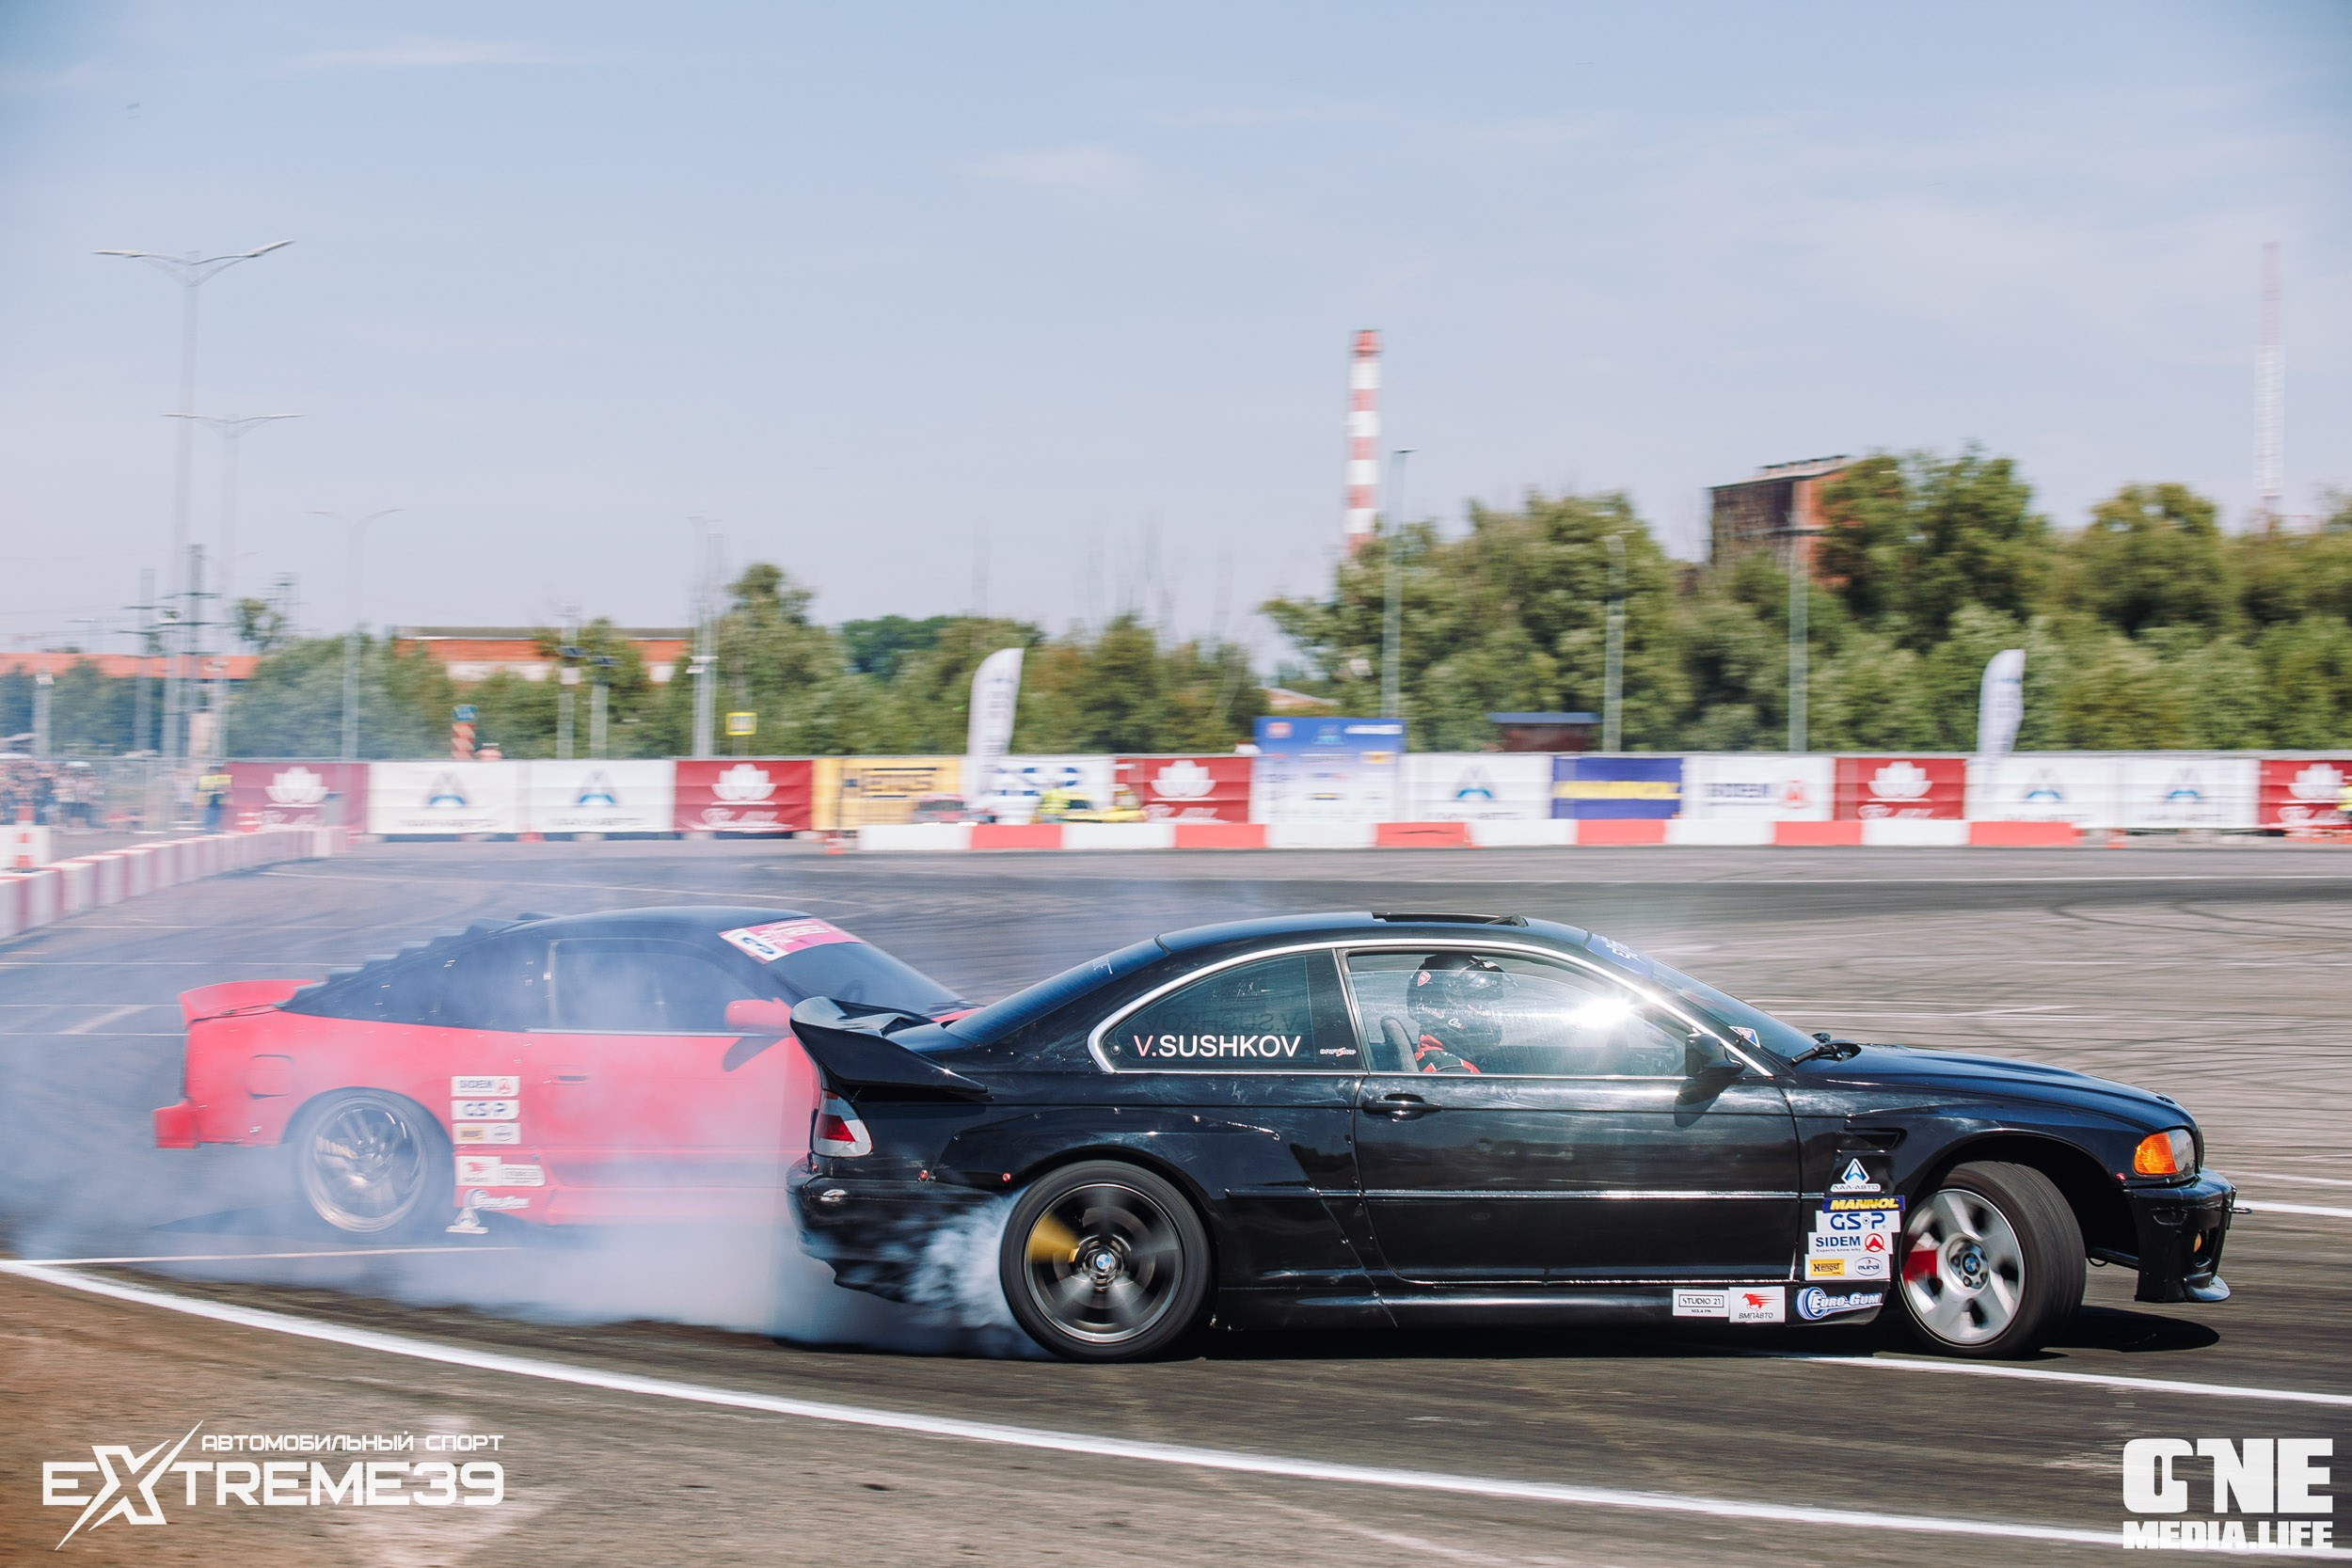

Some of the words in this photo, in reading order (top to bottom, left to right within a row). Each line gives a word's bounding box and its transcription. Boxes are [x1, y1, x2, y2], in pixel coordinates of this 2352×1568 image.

[1134, 1035, 1301, 1057] V.SUSHKOV
[1829, 1197, 1899, 1211] MANNOL
[1815, 1235, 1861, 1247] SIDEM
[1682, 1297, 1711, 1306] STUDIO
